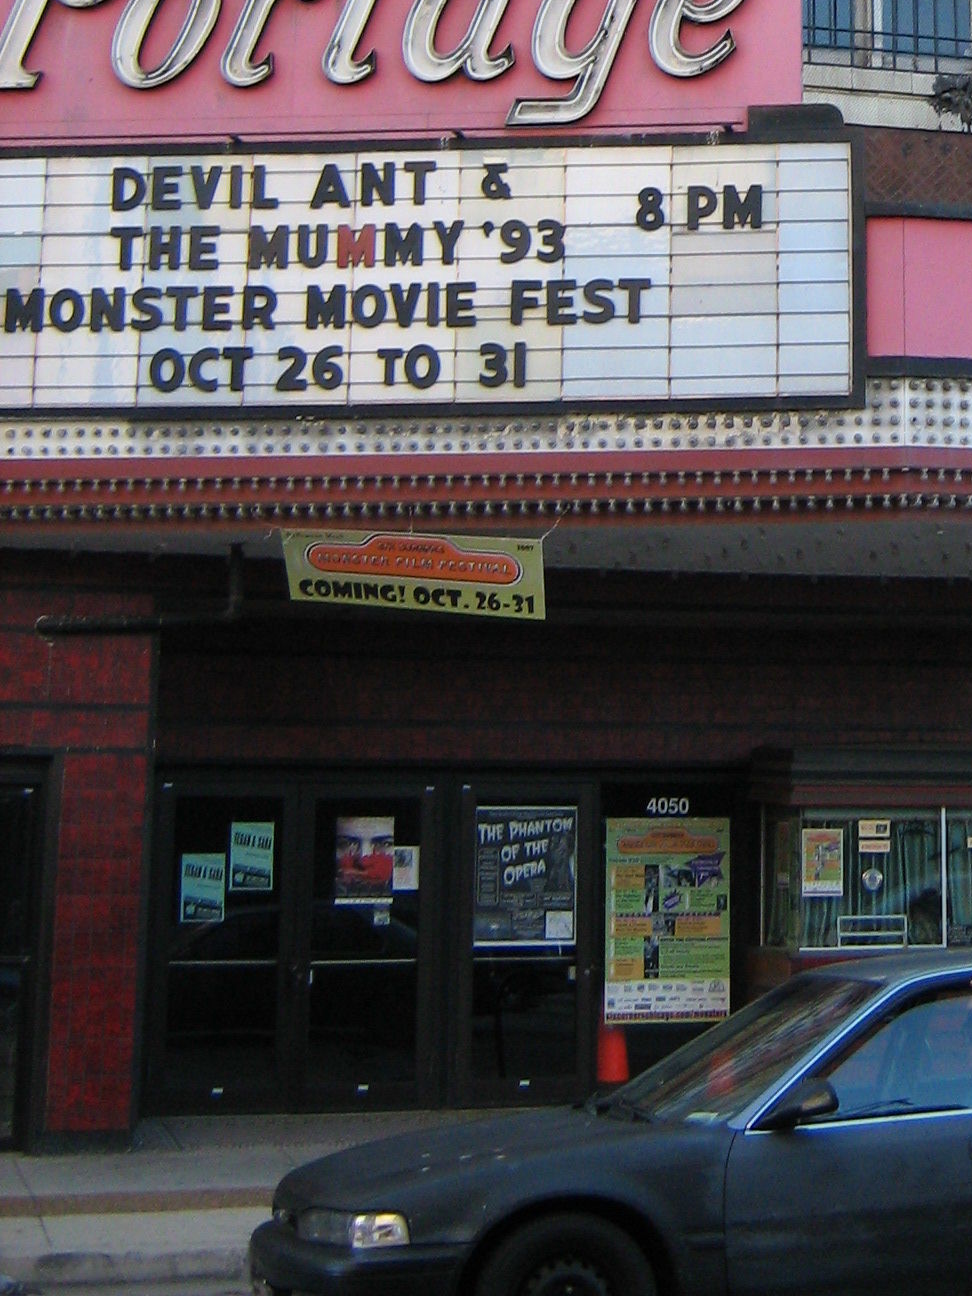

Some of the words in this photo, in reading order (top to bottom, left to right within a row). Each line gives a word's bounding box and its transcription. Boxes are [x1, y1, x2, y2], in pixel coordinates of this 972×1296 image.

[111, 163, 279, 212] DEVIL
[310, 160, 437, 209] ANT
[480, 161, 512, 200] &
[636, 186, 666, 231] 8
[686, 184, 763, 229] PM
[110, 225, 220, 272] THE
[248, 220, 465, 270] MUMMY
[3, 284, 278, 333] MONSTER
[304, 281, 477, 329] MOVIE
[509, 277, 652, 326] FEST
[148, 346, 255, 393] OCT
[275, 345, 345, 392] 26
[377, 343, 441, 390] TO
[478, 341, 527, 388] 31
[317, 552, 389, 567] MONSTER
[395, 555, 434, 570] FILM
[299, 579, 405, 603] COMING!
[413, 586, 470, 609] OCT.
[475, 590, 535, 614] 26-31
[646, 797, 690, 814] 4050
[477, 823, 505, 845] THE
[509, 816, 573, 842] PHANTOM
[500, 845, 524, 863] OF
[525, 839, 549, 857] THE
[503, 858, 547, 886] OPERA
